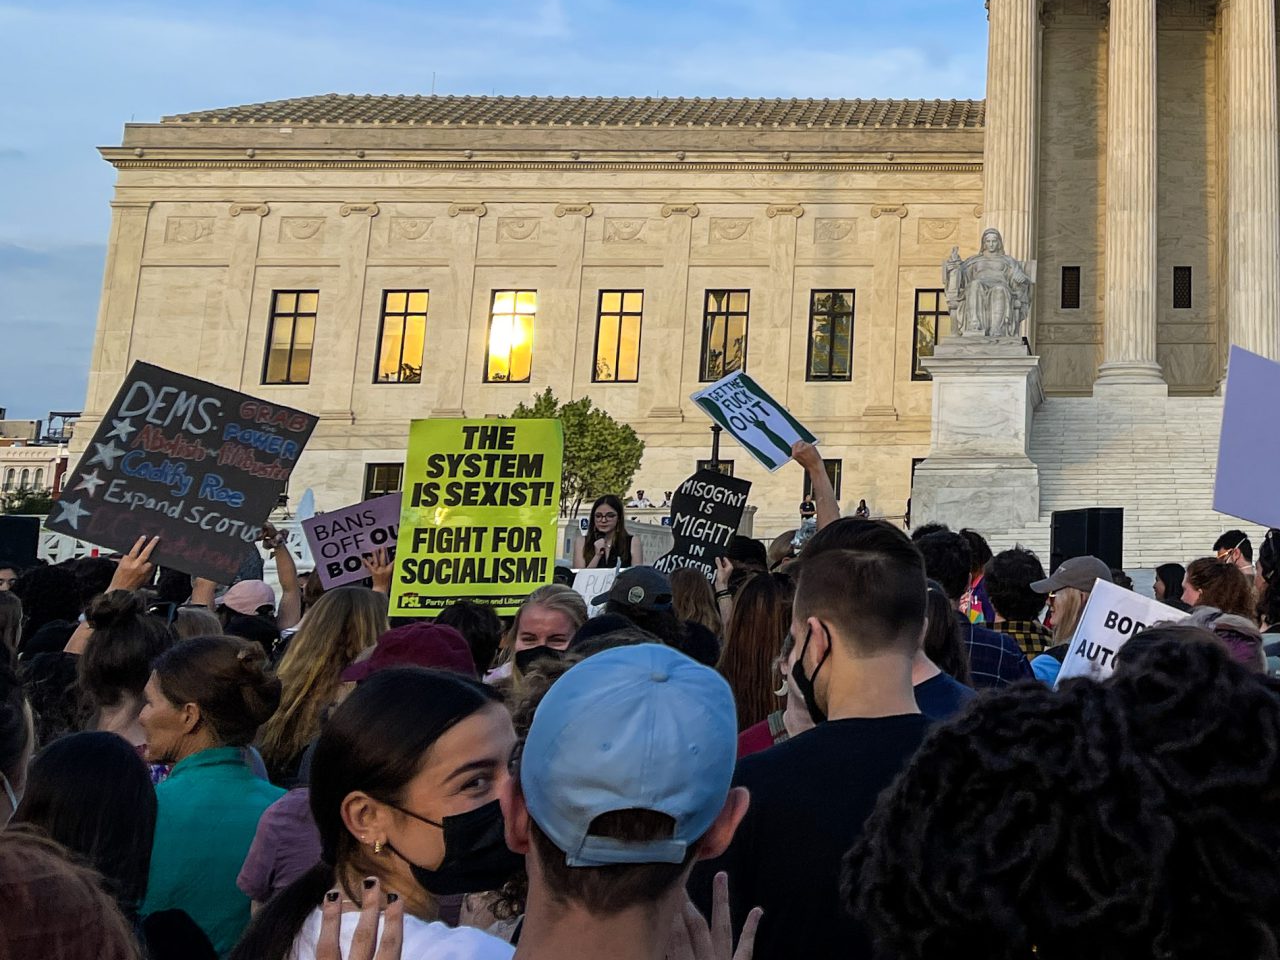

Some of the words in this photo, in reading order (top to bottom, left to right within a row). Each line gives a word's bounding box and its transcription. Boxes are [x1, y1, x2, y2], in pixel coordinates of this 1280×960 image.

[708, 384, 727, 401] GET
[725, 377, 744, 392] THE
[721, 390, 754, 413] FUCK
[117, 380, 224, 435] DEMS:
[239, 401, 309, 433] GRAB
[729, 401, 771, 431] OUT
[223, 422, 299, 460] POWER
[462, 426, 516, 450] THE
[426, 453, 544, 479] SYSTEM
[199, 473, 245, 507] Roe
[410, 482, 440, 507] IS
[444, 481, 555, 507] SEXIST!
[681, 479, 747, 508] MISOGYNY
[103, 478, 184, 519] Expand
[184, 506, 262, 543] SCOTUS
[699, 500, 714, 514] IS
[313, 510, 377, 541] BANS
[672, 512, 736, 547] MIGHTY
[321, 532, 365, 559] OFF
[370, 523, 400, 545] OU
[411, 527, 487, 554] FIGHT
[492, 526, 543, 553] FOR
[688, 544, 705, 557] IN
[401, 557, 548, 584] SOCIALISM!
[401, 596, 421, 608] PSL
[425, 599, 445, 607] Party
[1104, 610, 1147, 635] BOD
